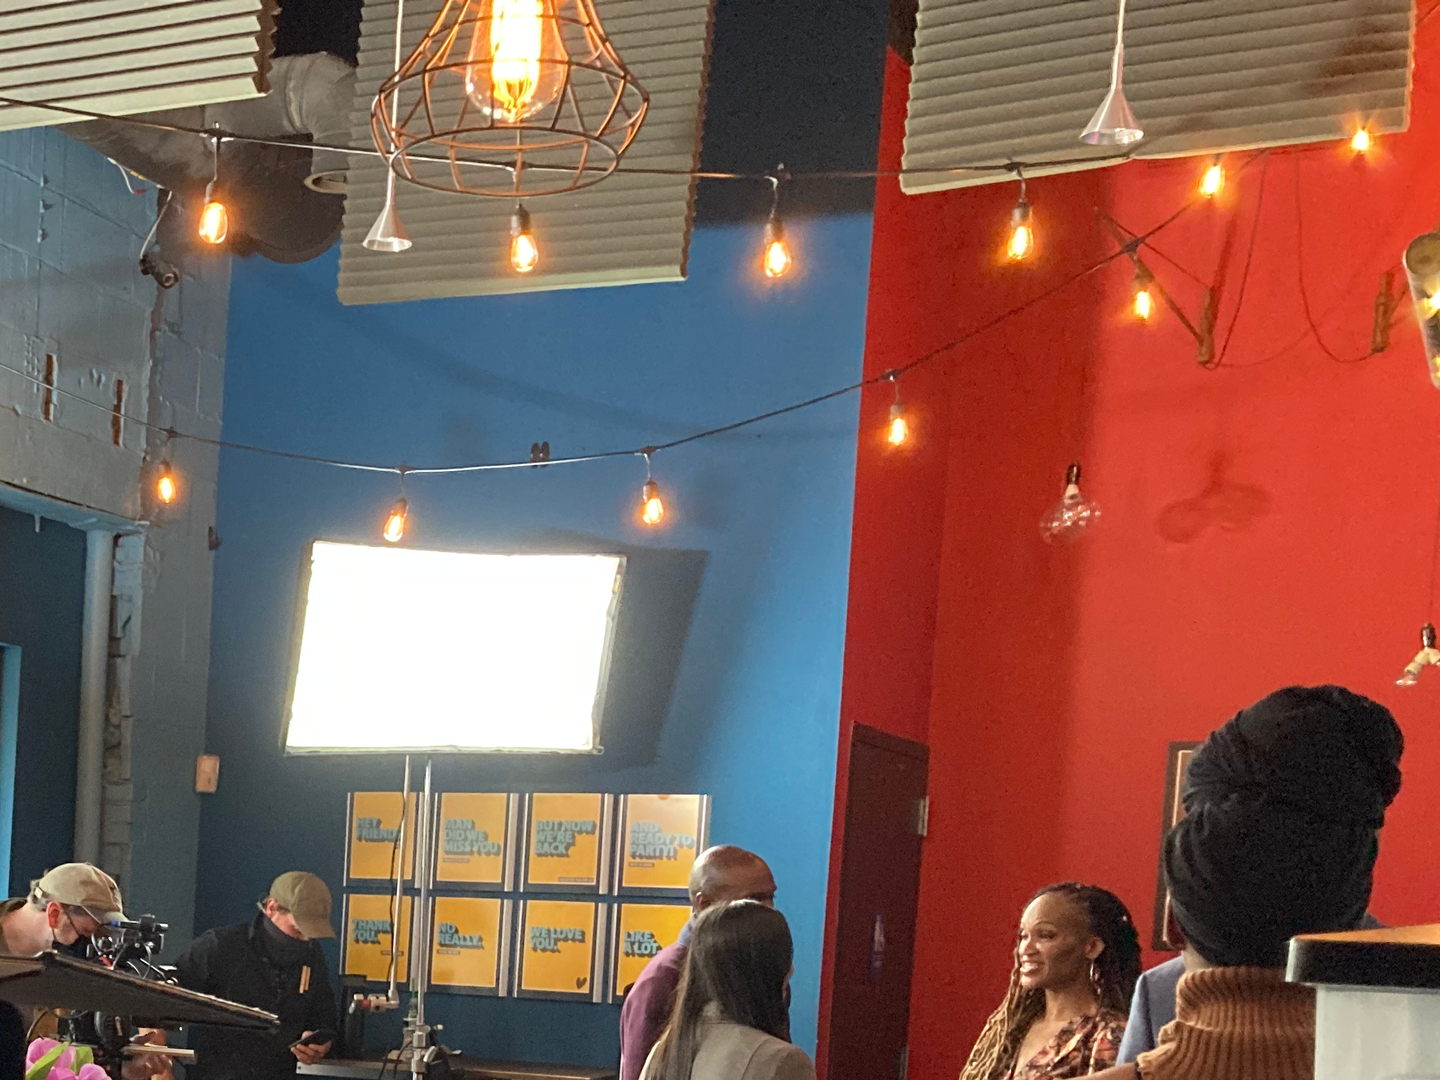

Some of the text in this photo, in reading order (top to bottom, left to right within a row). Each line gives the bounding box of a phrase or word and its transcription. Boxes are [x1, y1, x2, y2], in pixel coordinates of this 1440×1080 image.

[358, 817, 379, 829] HEY
[445, 819, 473, 831] MAN
[536, 820, 595, 833] BUT NOW
[357, 828, 401, 842] FRIEND
[445, 829, 487, 843] DID WE
[536, 831, 573, 843] WE'RE
[631, 833, 694, 846] READY TO
[444, 841, 500, 855] MISS YOU
[535, 842, 568, 855] BACK
[630, 845, 675, 858] PARTY!
[353, 919, 392, 932] THANK
[353, 930, 378, 941] YOU.
[438, 934, 482, 946] REALLY.
[531, 927, 583, 940] WE LOVE
[624, 932, 655, 943] LIKE,
[531, 938, 558, 950] YOU.
[624, 942, 633, 953] A
